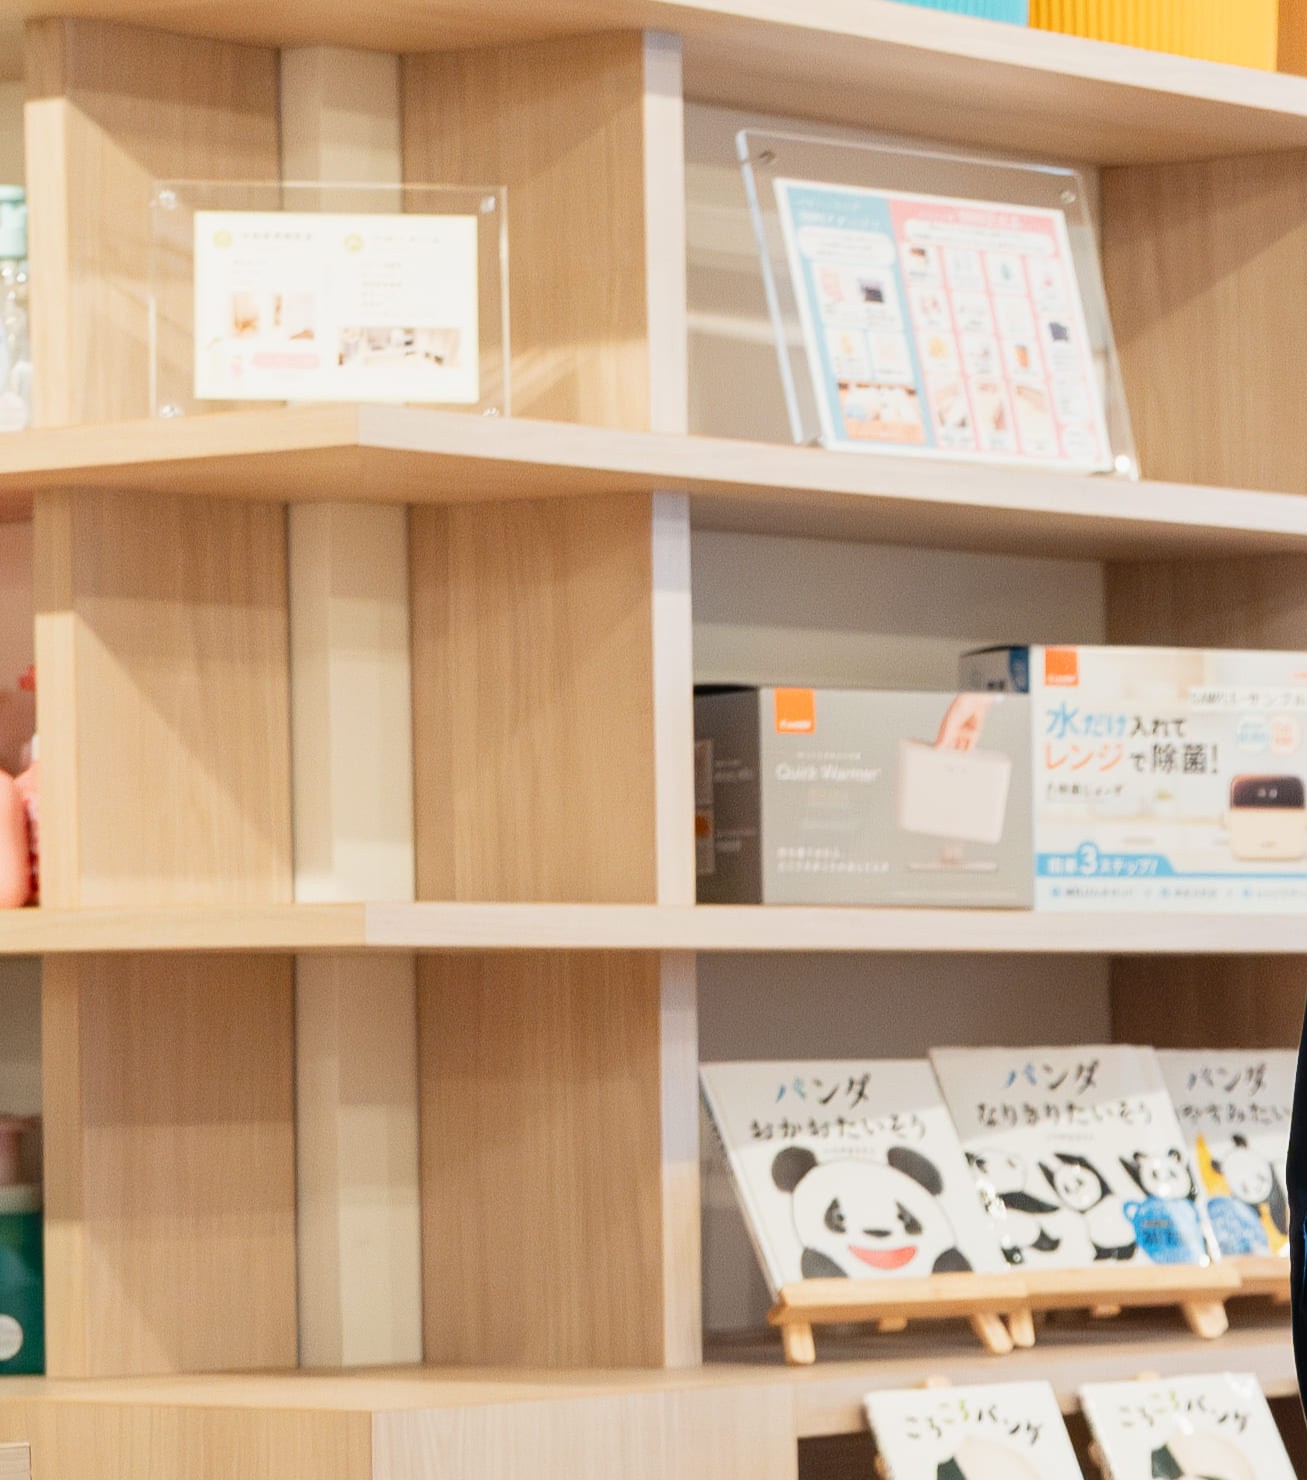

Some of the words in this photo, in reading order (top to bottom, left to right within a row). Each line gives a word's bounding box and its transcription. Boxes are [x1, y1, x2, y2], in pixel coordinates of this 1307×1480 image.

[1045, 703, 1188, 745] 水だけ入れて
[775, 1072, 871, 1110] パンダ
[1005, 1059, 1099, 1094] パンダ
[1186, 1062, 1267, 1097] パンダ
